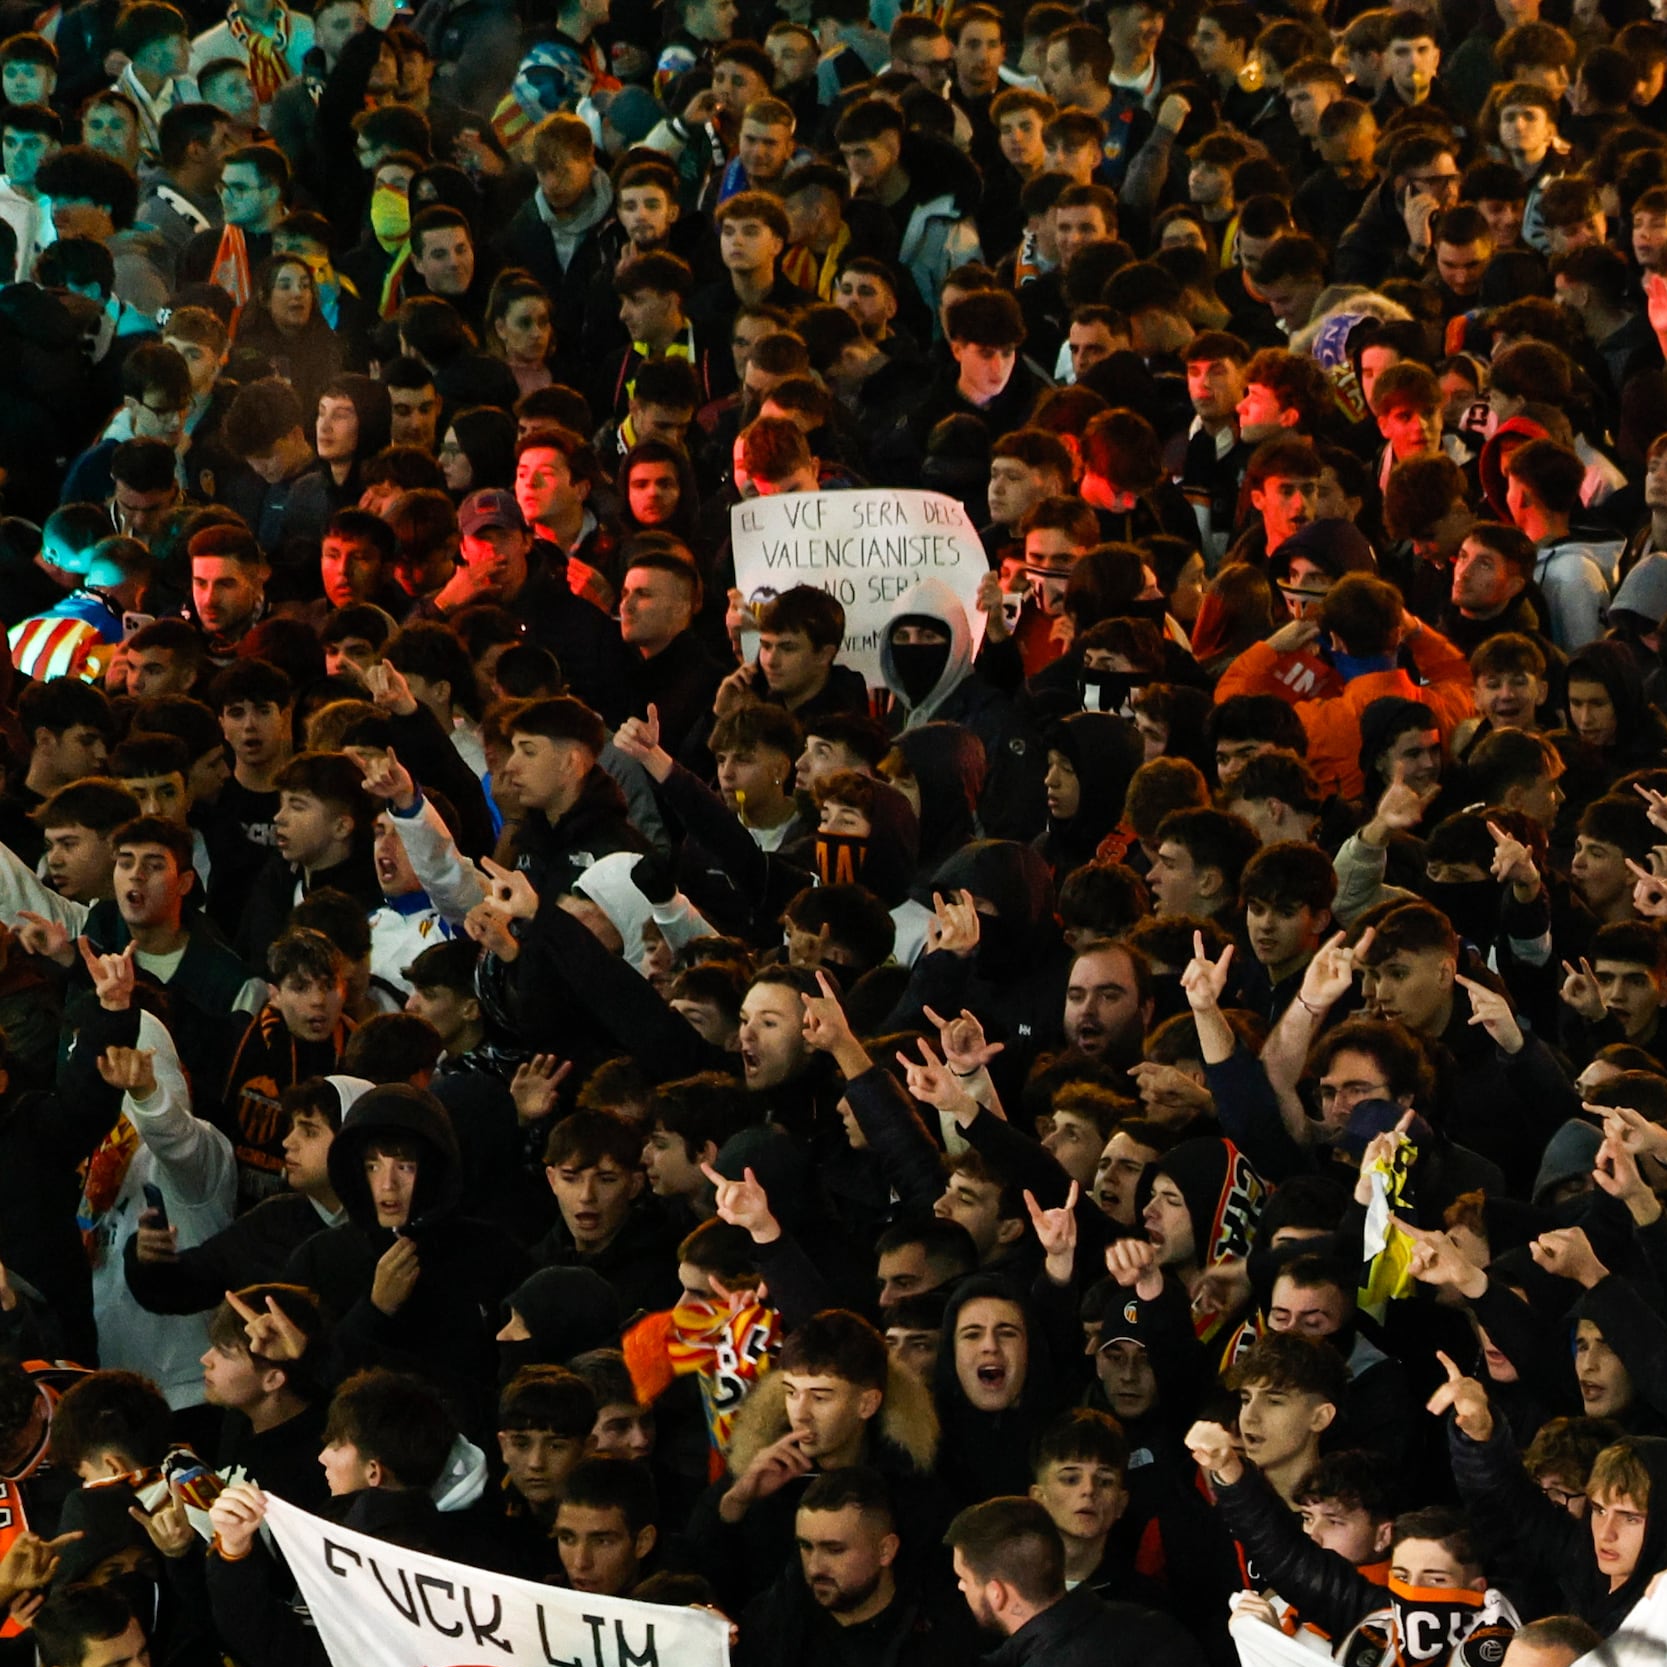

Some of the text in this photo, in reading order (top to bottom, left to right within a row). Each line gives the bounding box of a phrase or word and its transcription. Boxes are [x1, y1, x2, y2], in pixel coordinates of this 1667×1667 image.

[741, 512, 765, 533] EL
[783, 499, 829, 531] VCF
[852, 492, 908, 528] SERÀ
[762, 535, 961, 569] VALENCIANISTES
[867, 573, 920, 604] SER
